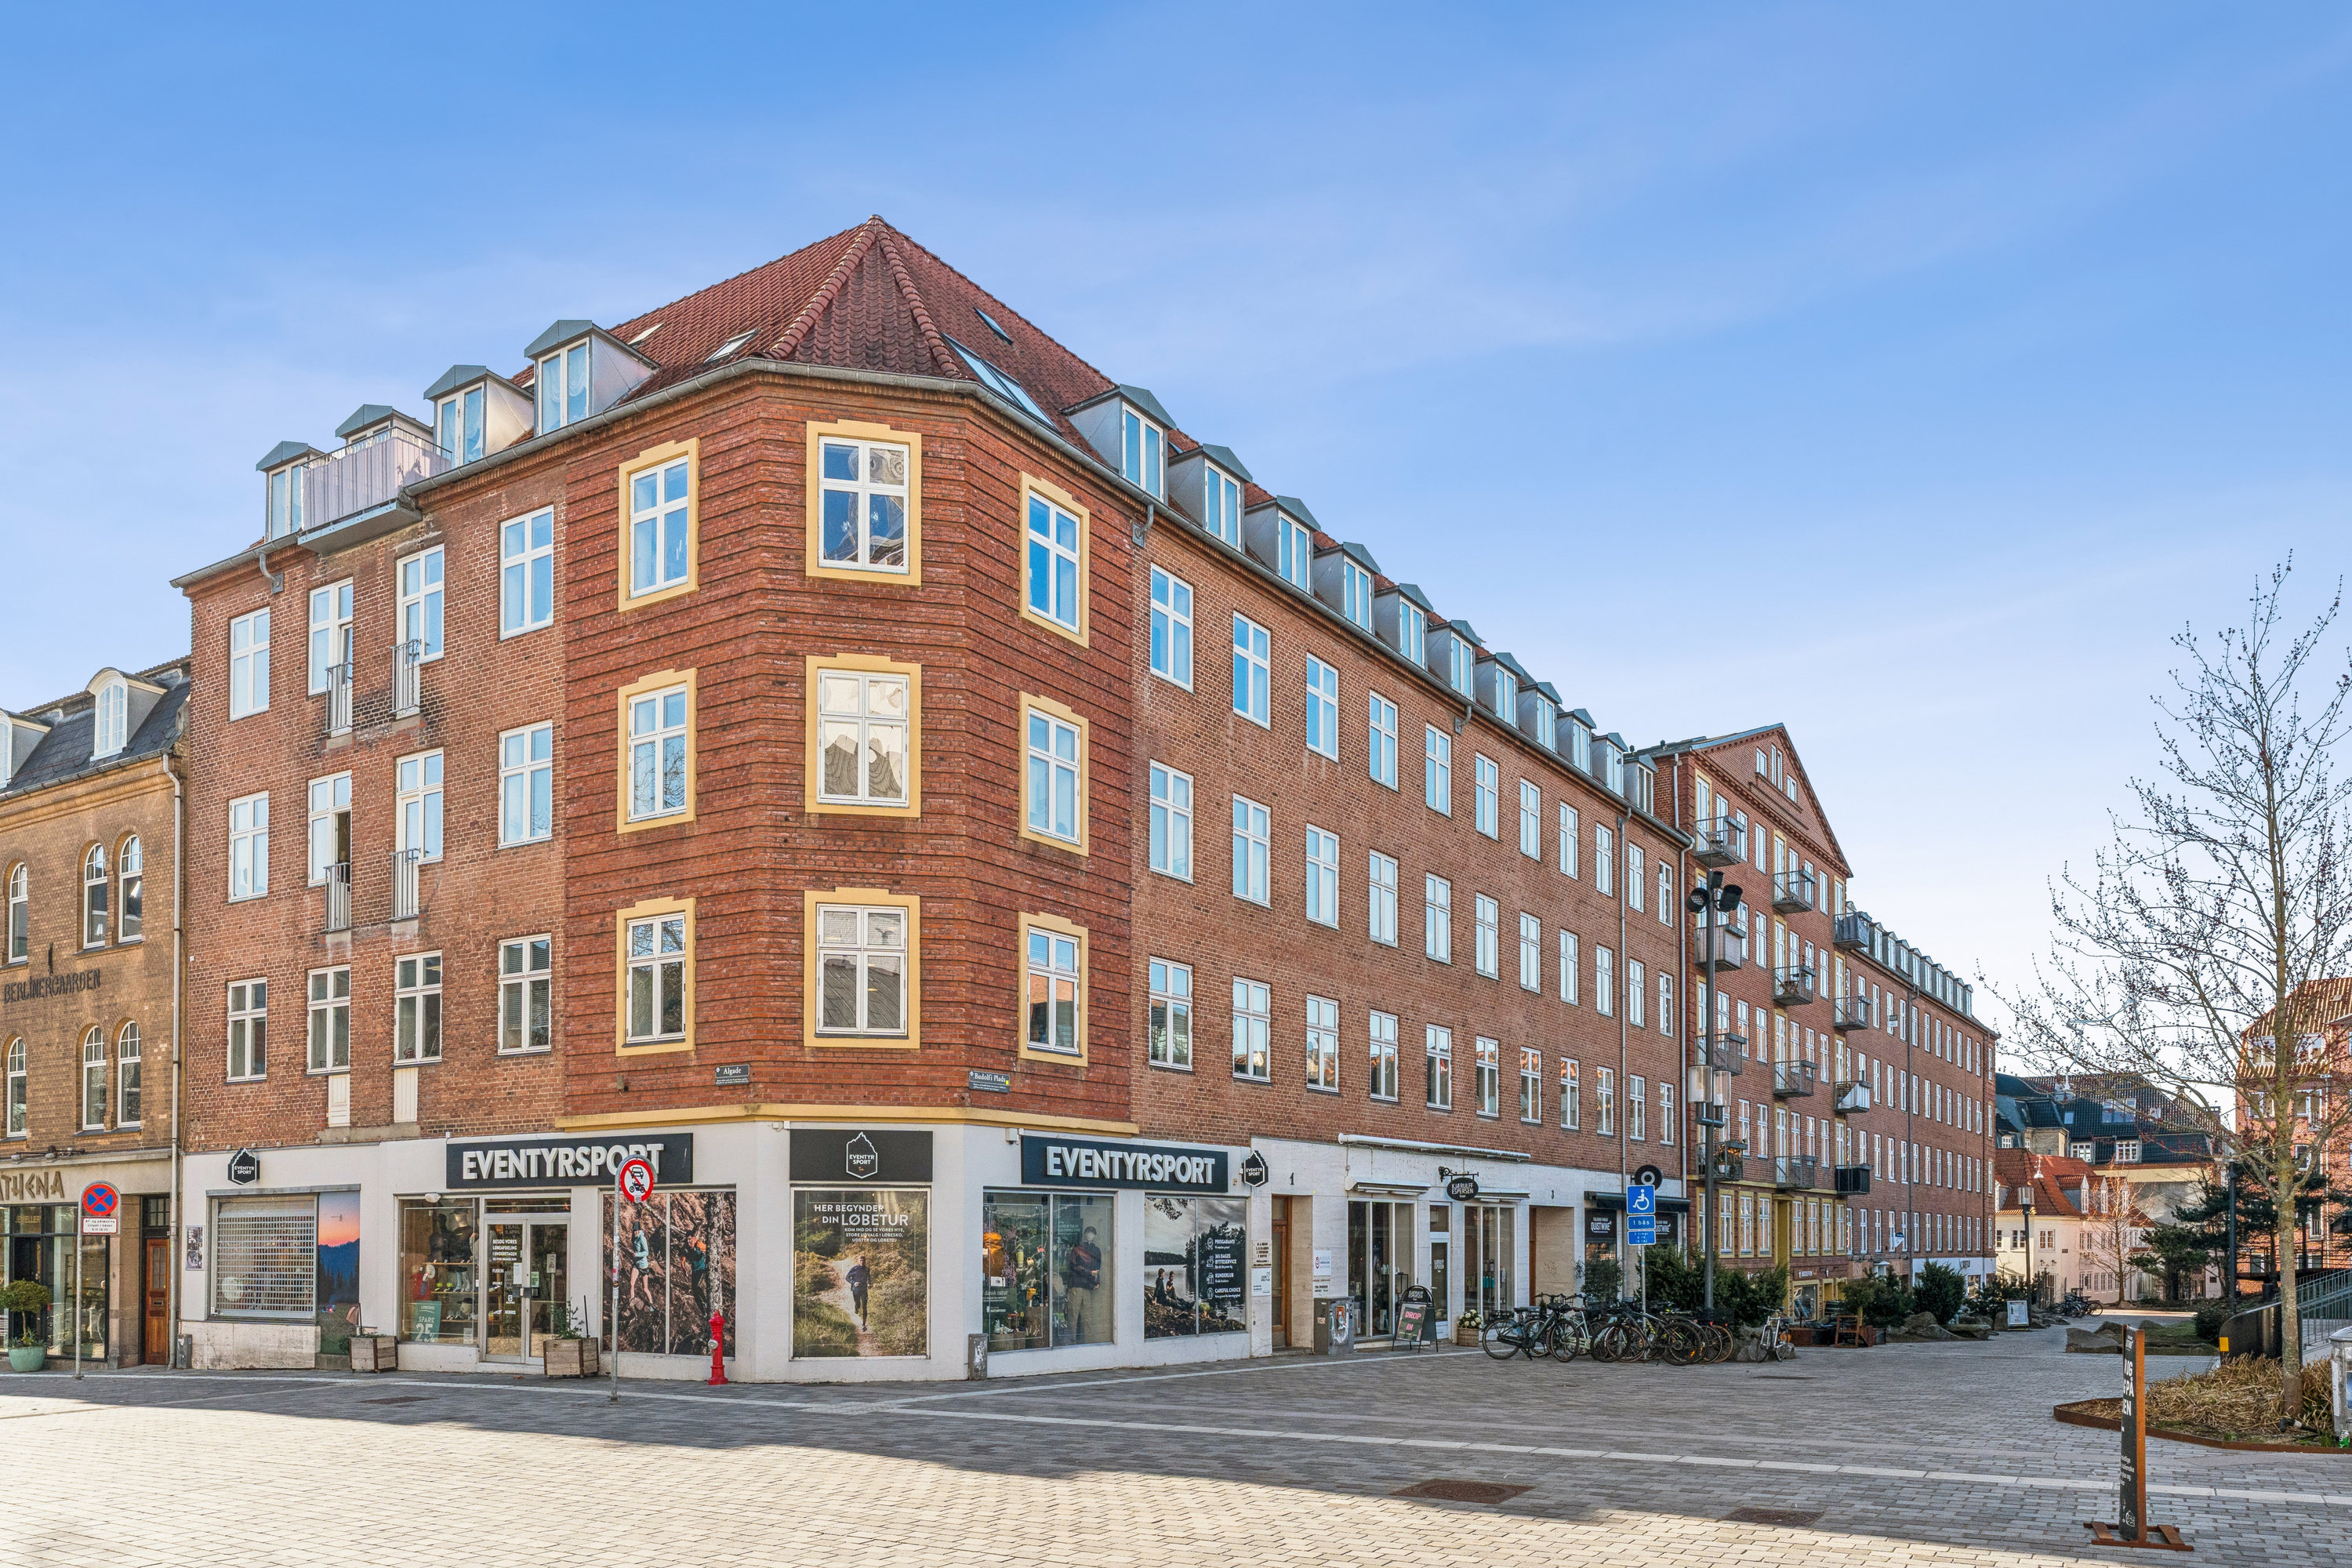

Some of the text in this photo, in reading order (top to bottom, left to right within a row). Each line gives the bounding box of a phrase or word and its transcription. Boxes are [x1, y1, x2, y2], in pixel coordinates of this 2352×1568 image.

[723, 1067, 742, 1076] Algade
[975, 1073, 993, 1081] Budolfi
[1046, 1145, 1215, 1185] EVENTYRSPORT
[1290, 1172, 1295, 1185] 1
[1551, 1189, 1555, 1200] 3
[841, 1214, 909, 1226] LØBETUR
[1404, 1311, 1421, 1319] DROP
